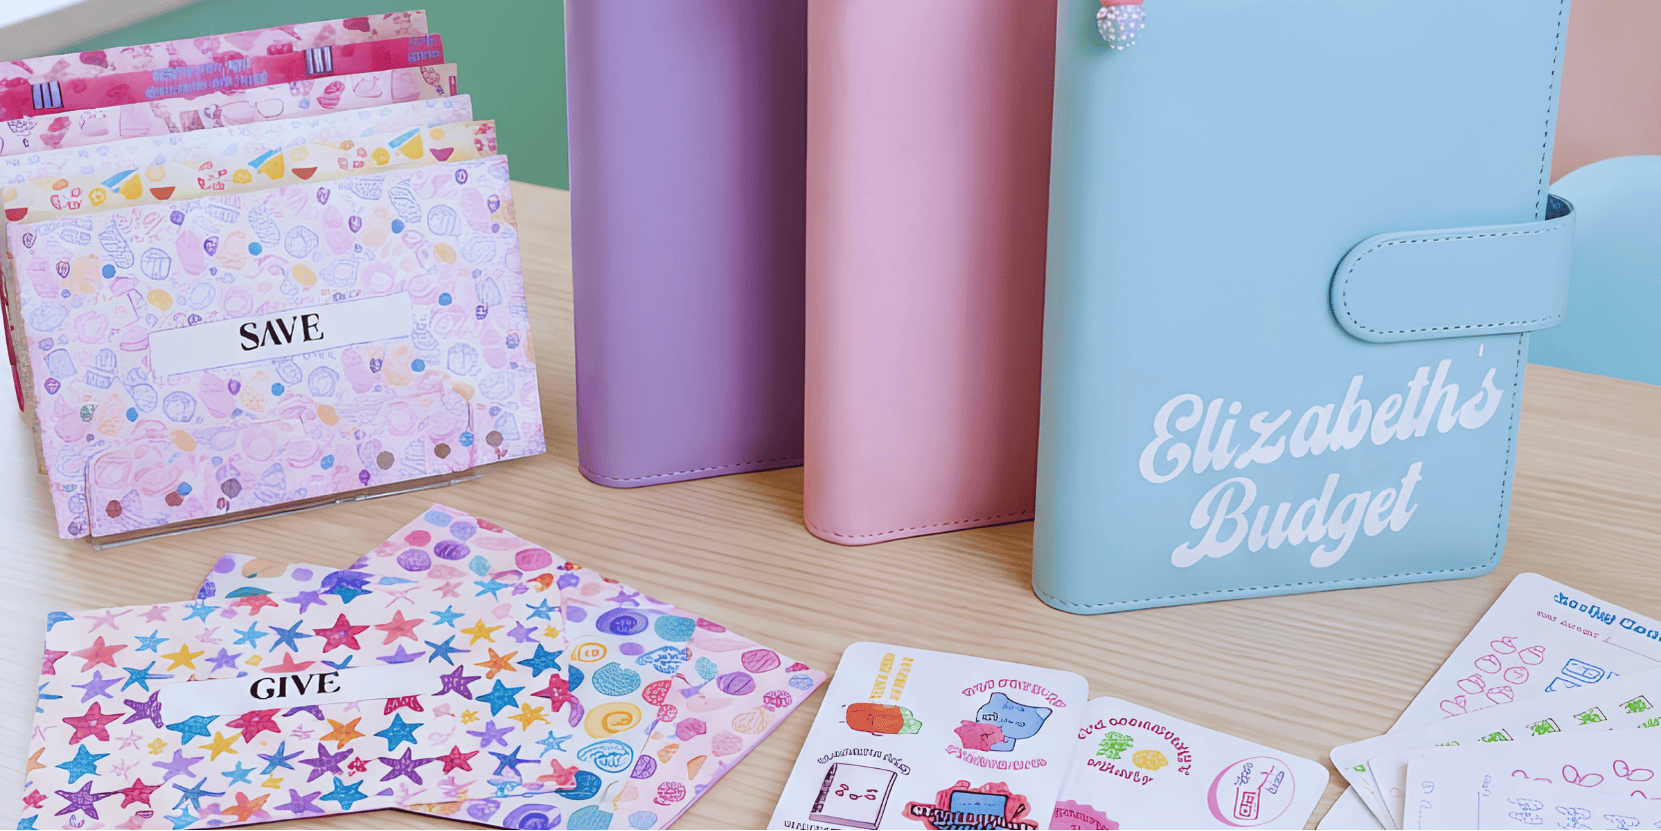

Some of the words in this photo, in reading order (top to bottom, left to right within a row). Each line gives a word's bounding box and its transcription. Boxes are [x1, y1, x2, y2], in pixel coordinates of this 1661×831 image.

[239, 313, 324, 351] SAVE
[1139, 344, 1504, 484] Elizabeth's
[1171, 461, 1423, 568] Budget
[250, 671, 341, 700] GIVE
